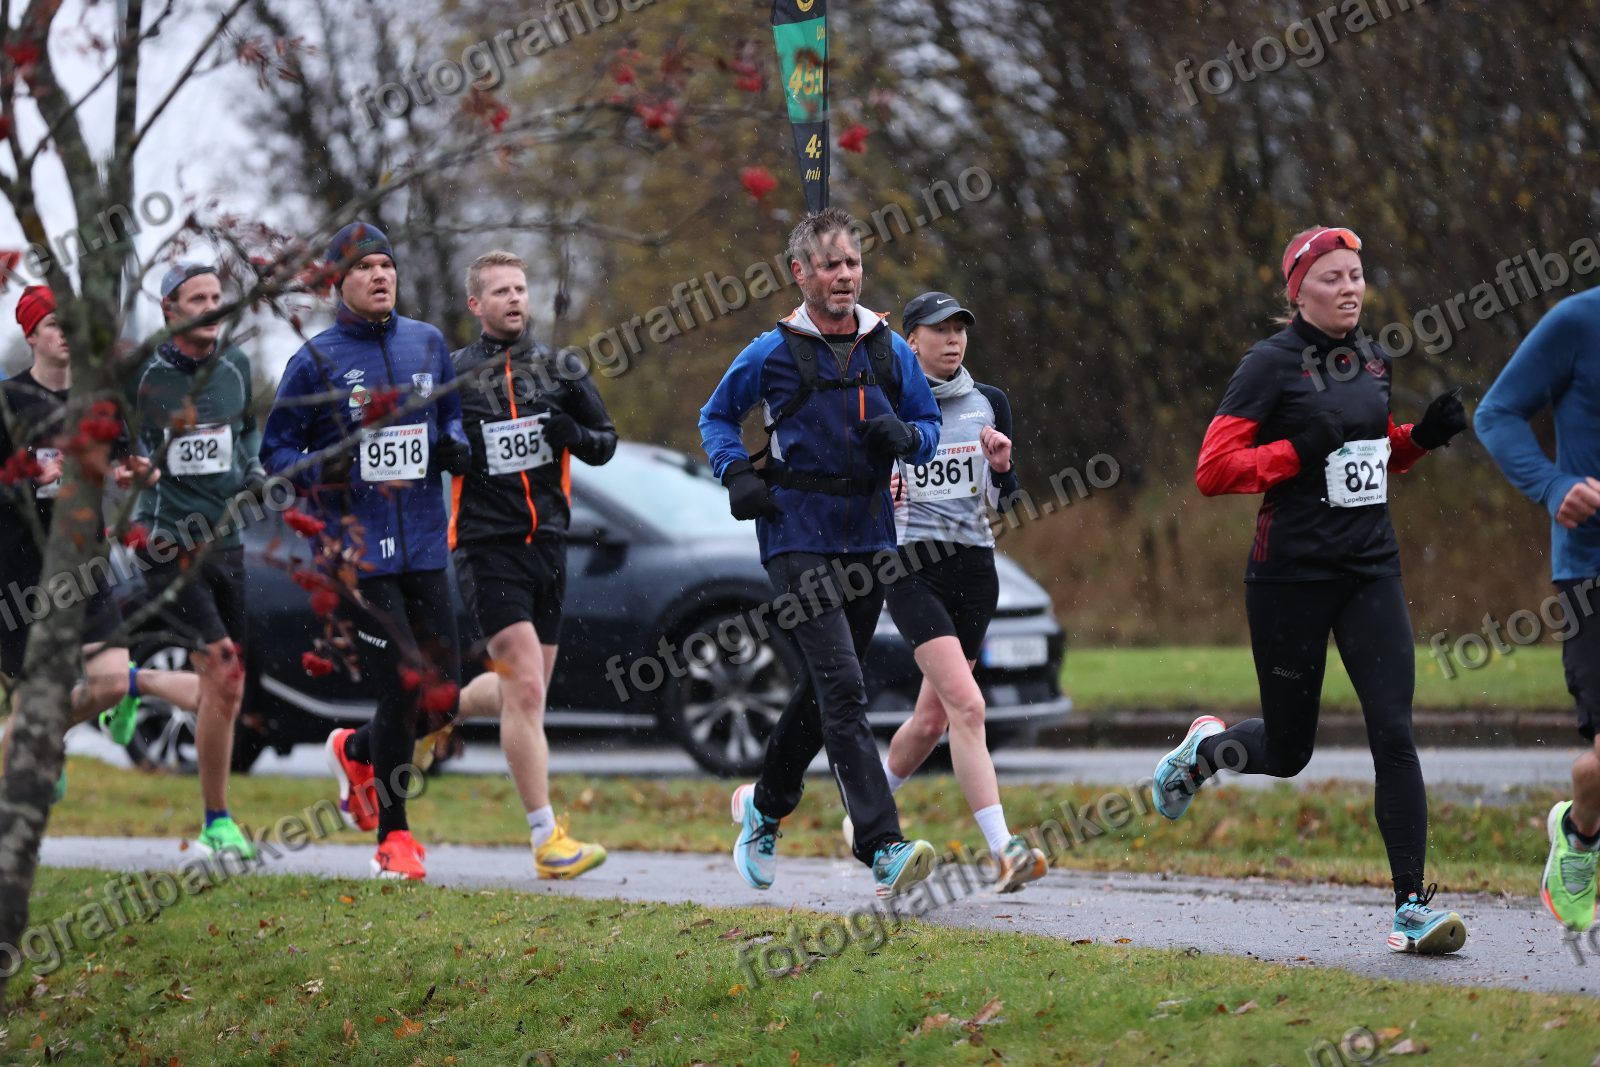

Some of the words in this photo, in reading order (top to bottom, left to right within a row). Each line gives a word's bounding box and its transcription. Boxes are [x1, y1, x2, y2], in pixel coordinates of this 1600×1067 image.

[181, 439, 218, 462] 382
[368, 439, 423, 468] 9518
[499, 430, 540, 459] 385
[914, 457, 974, 488] 9361
[1345, 459, 1385, 492] 821
[380, 537, 395, 559] TN
